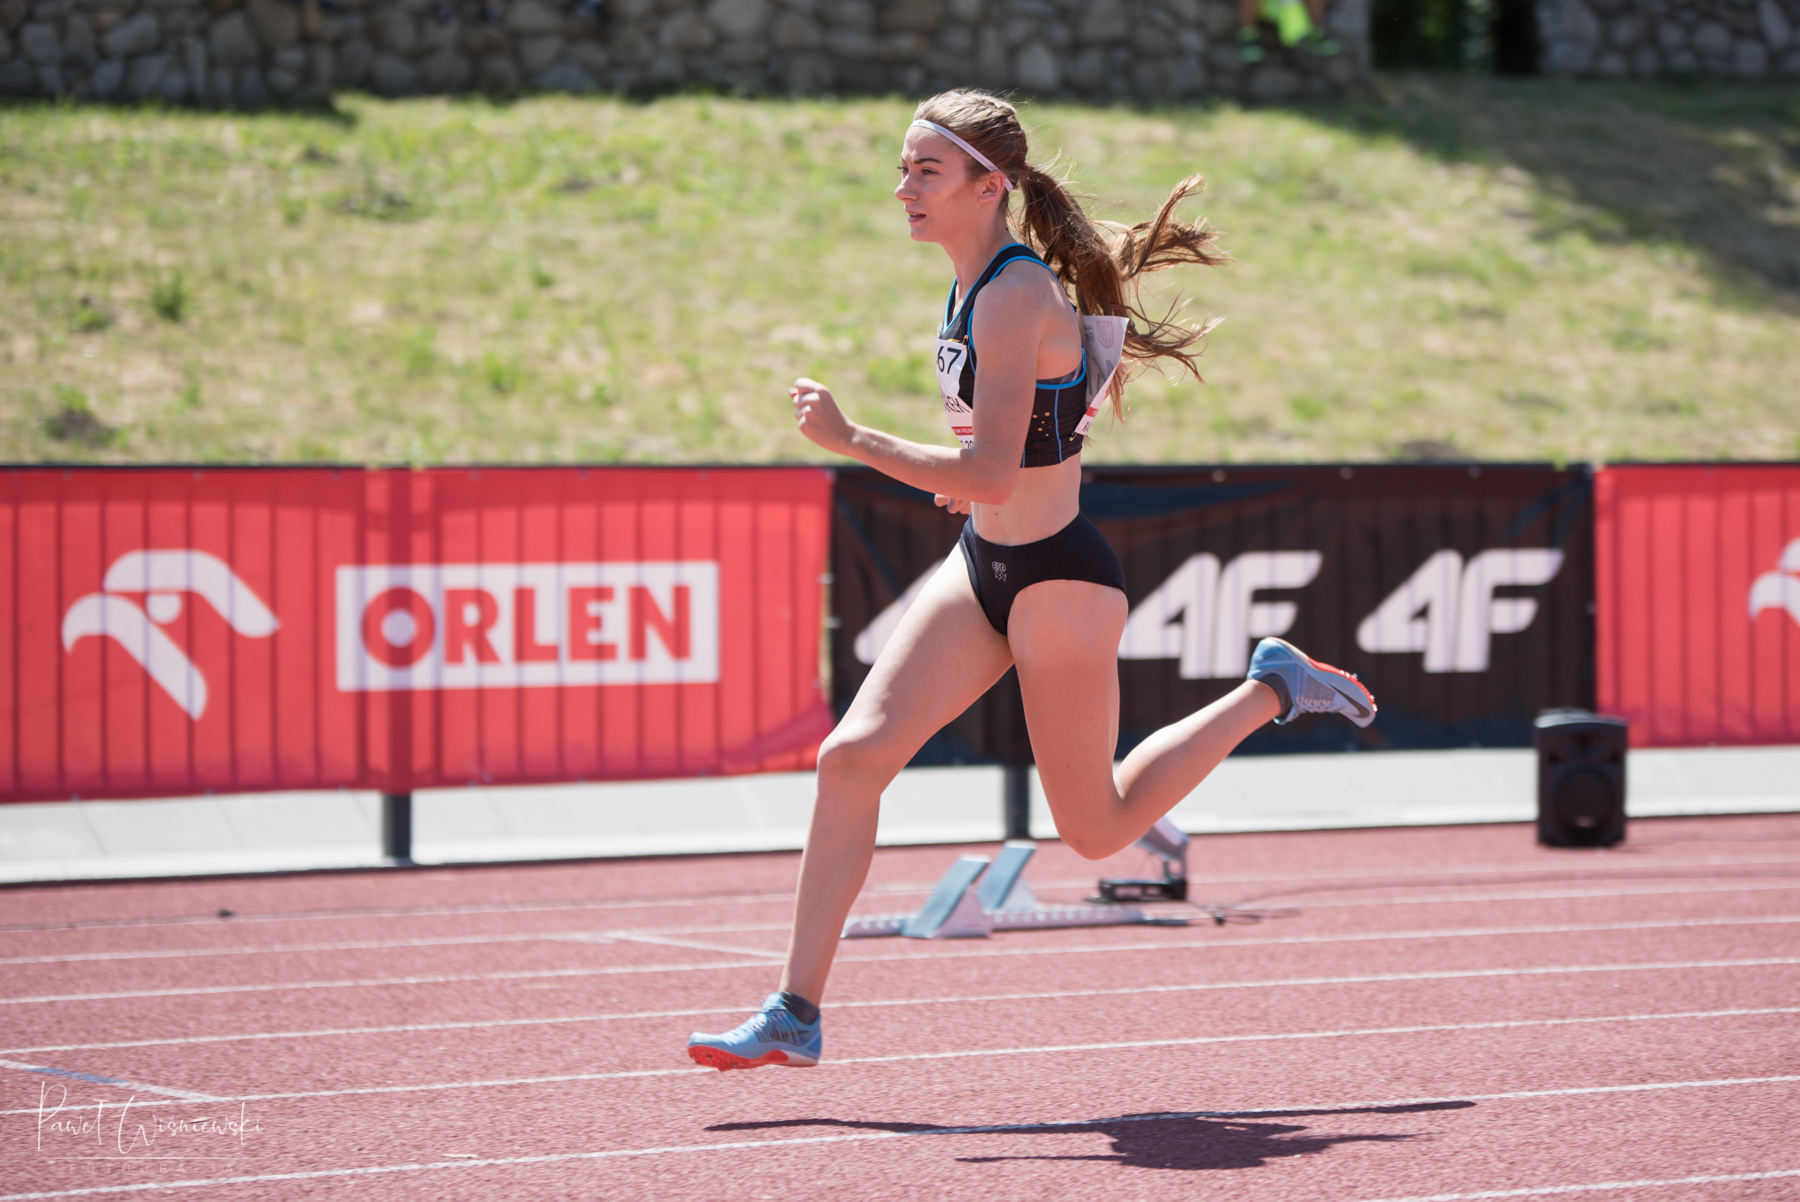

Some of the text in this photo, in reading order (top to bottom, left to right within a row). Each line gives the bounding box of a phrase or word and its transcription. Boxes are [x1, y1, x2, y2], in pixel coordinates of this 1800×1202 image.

[937, 345, 962, 375] 67
[360, 583, 694, 671] ORLEN
[1118, 548, 1565, 680] 4F 4F
